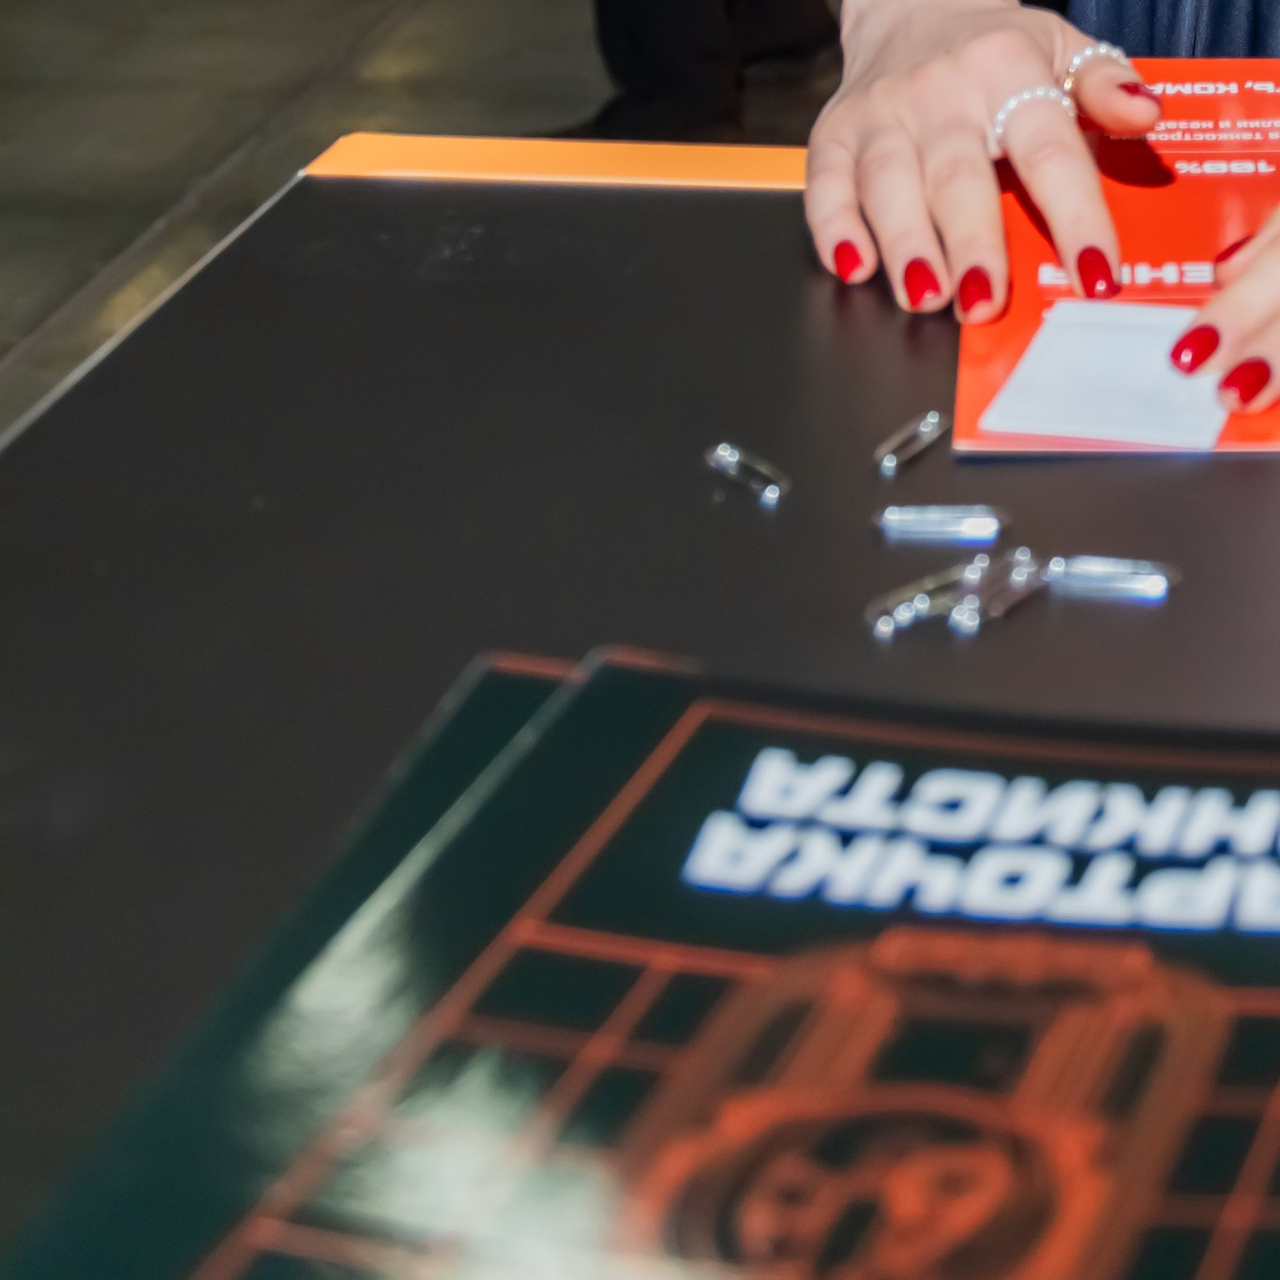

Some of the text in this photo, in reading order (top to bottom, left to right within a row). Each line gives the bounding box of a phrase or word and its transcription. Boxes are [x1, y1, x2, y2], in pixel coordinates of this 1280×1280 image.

[1145, 81, 1239, 95] КОМА
[1154, 120, 1214, 131] незаб
[1218, 119, 1232, 129] и
[1174, 159, 1276, 174] 100%
